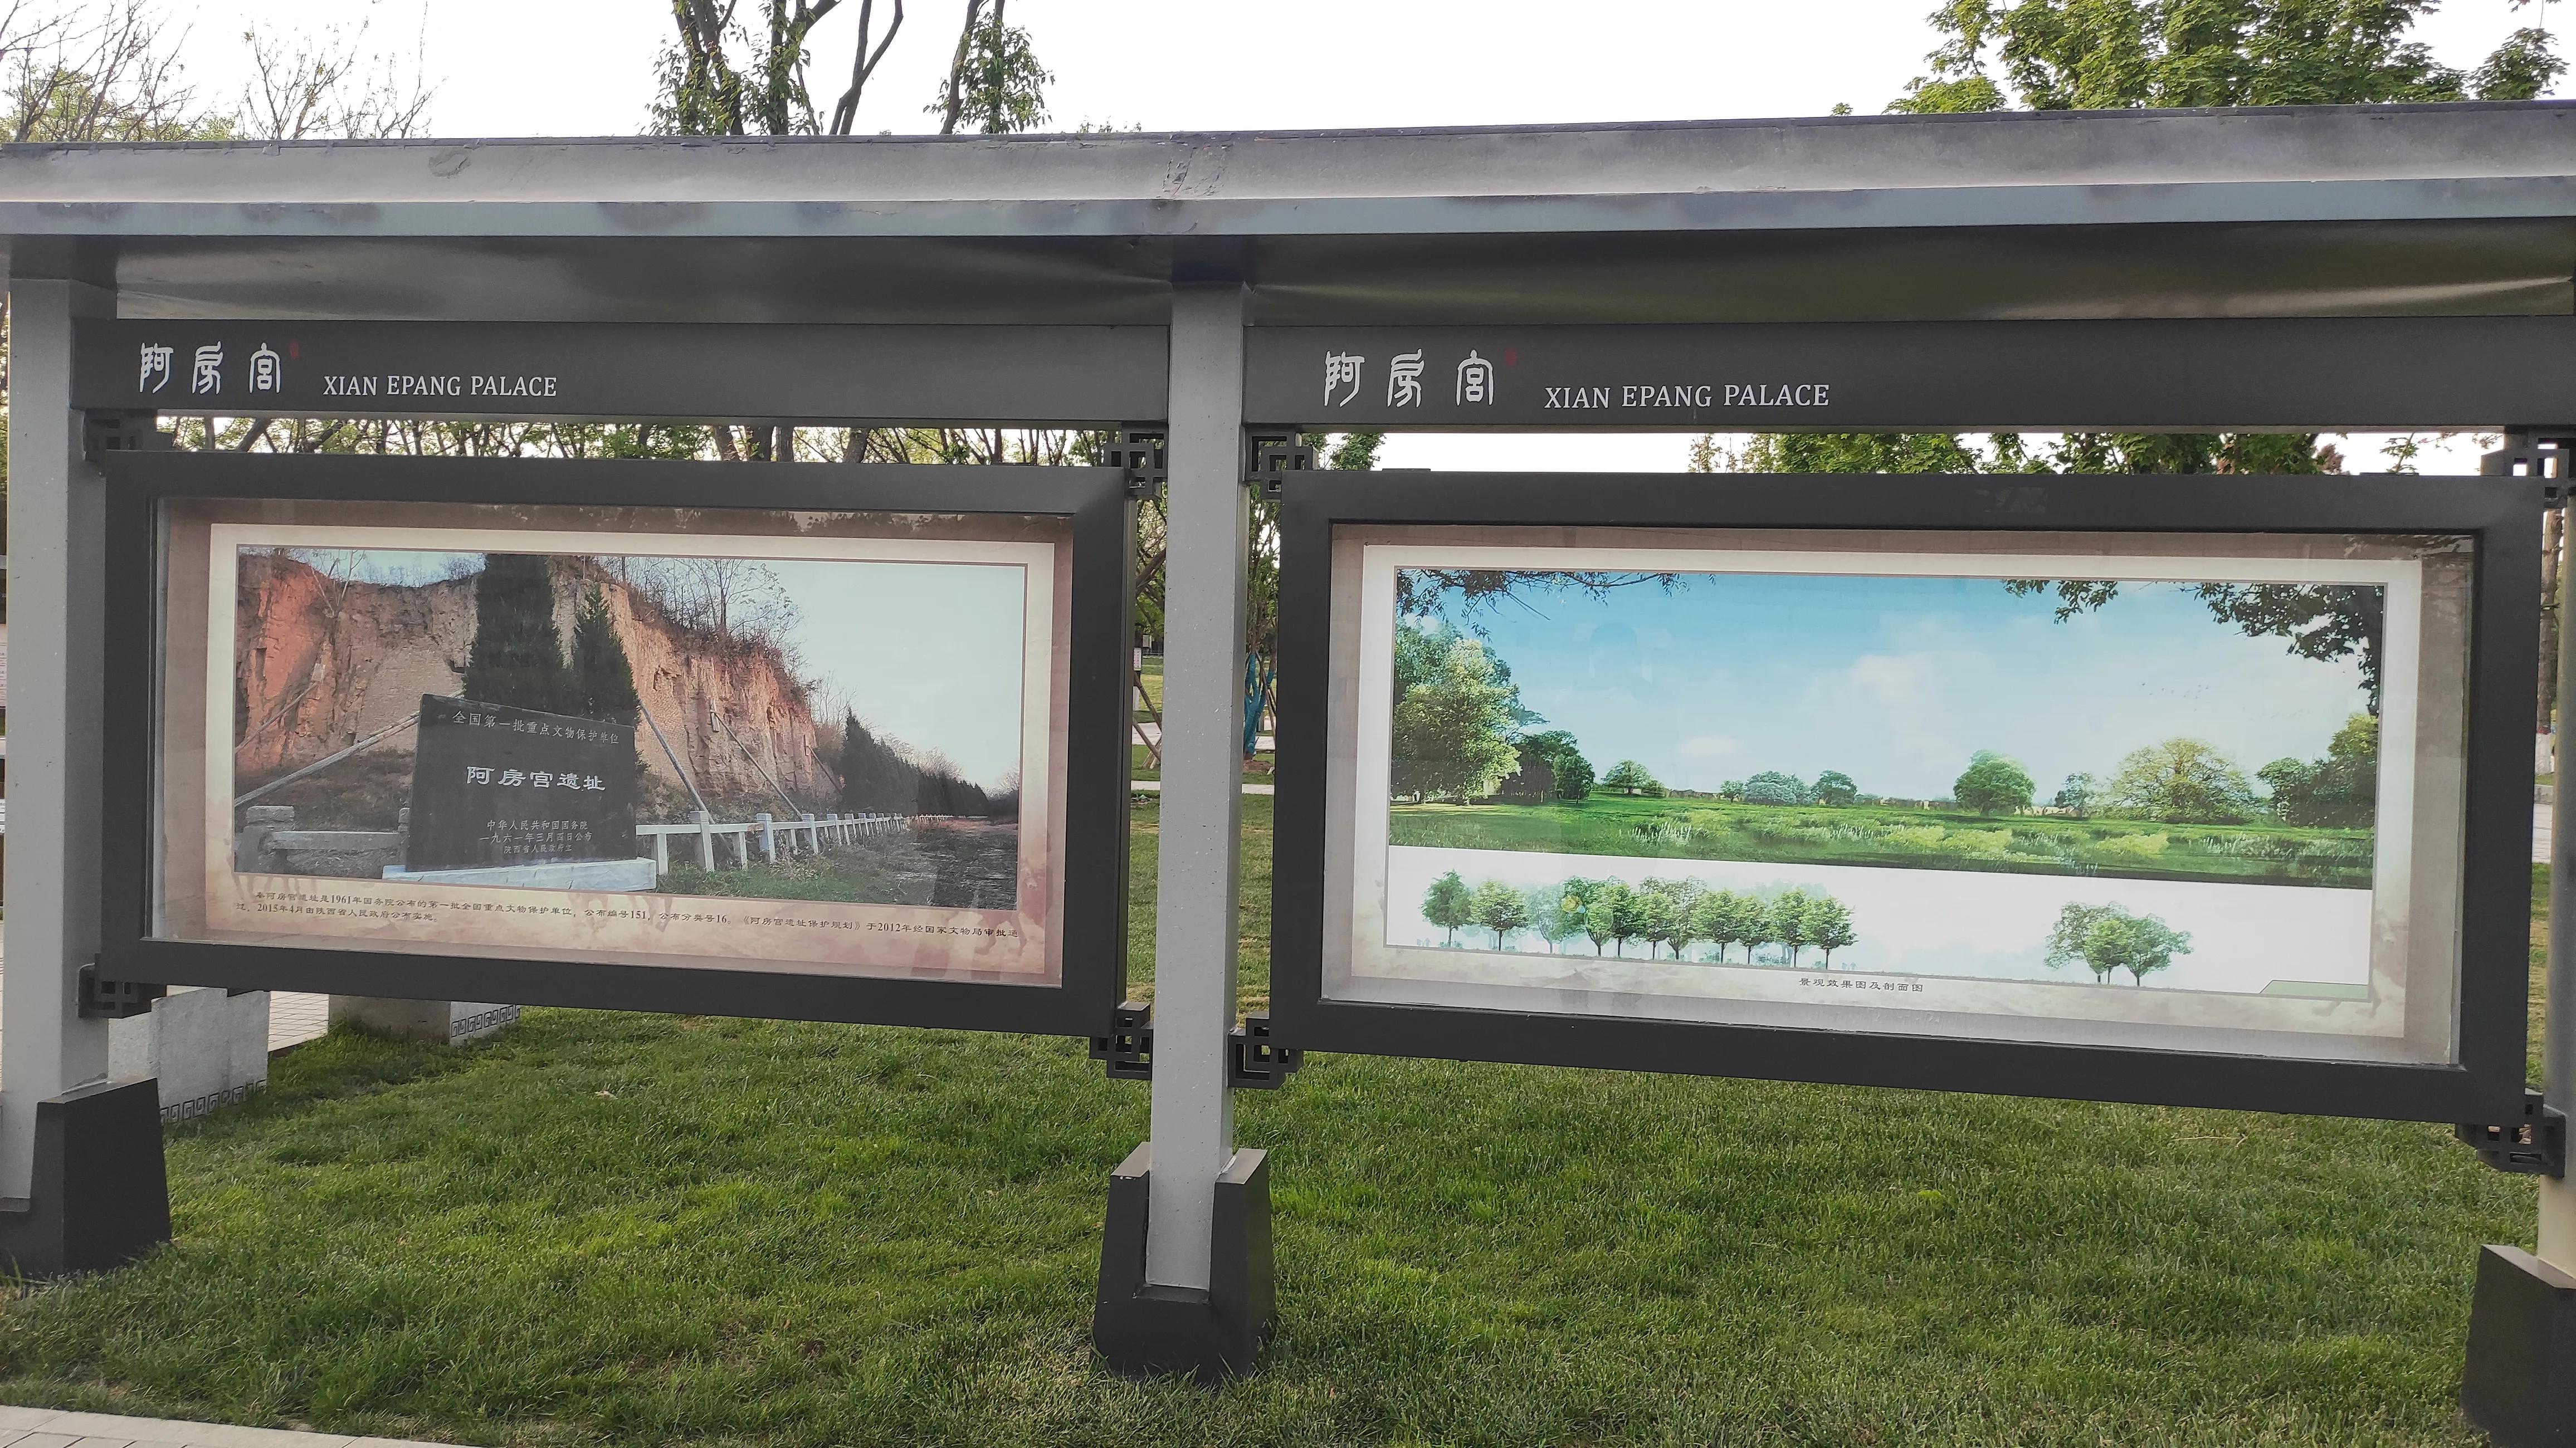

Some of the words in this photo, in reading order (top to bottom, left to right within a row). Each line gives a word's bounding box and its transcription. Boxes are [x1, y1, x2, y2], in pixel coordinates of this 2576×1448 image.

[323, 376, 378, 397] XIAN
[387, 376, 461, 397] EPANG
[470, 376, 557, 397] PALACE
[1545, 386, 1610, 409] XIAN
[1622, 385, 1712, 408] EPANG
[1723, 384, 1829, 407] PALACE
[466, 765, 606, 791] 阿房宫遗址
[1798, 977, 1923, 992] 景观效果图及剖面图
